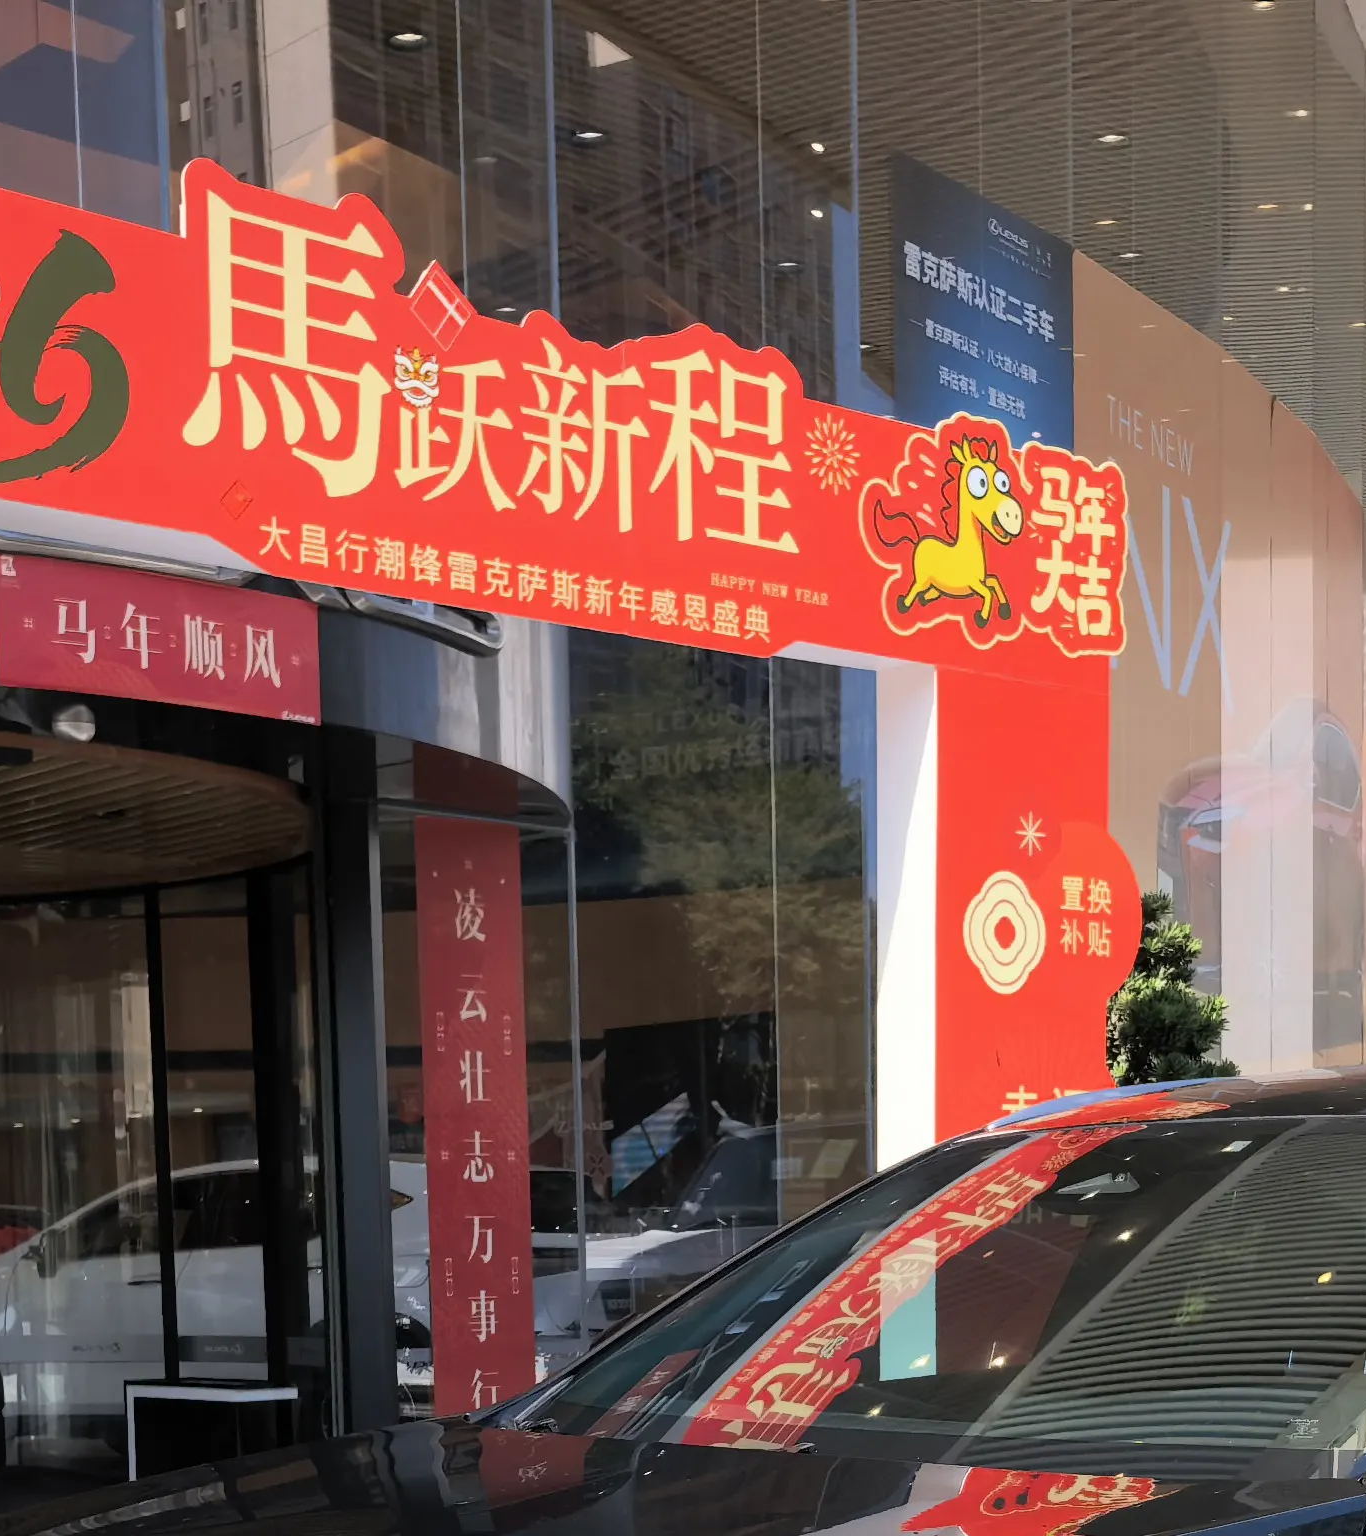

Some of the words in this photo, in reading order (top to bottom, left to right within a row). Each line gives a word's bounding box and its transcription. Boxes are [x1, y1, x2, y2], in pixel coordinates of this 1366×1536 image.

[903, 240, 1055, 342] 雷克萨斯认证二手车
[182, 188, 800, 554] 馬跃新程
[1107, 394, 1143, 451] THE
[1151, 418, 1195, 477] NEW
[1031, 467, 1116, 556] 马年
[258, 515, 771, 644] 大昌行潮锋雷克萨斯新年感恩盛典
[710, 572, 755, 593] HAPPY
[762, 581, 788, 599] NEW
[795, 587, 829, 607] YEAR
[1031, 540, 1112, 637] 大吉
[51, 598, 282, 688] 马年顺风
[1060, 875, 1112, 916] 置换
[1060, 918, 1112, 958] 补贴
[454, 887, 501, 1411] 凌云壮志万事行
